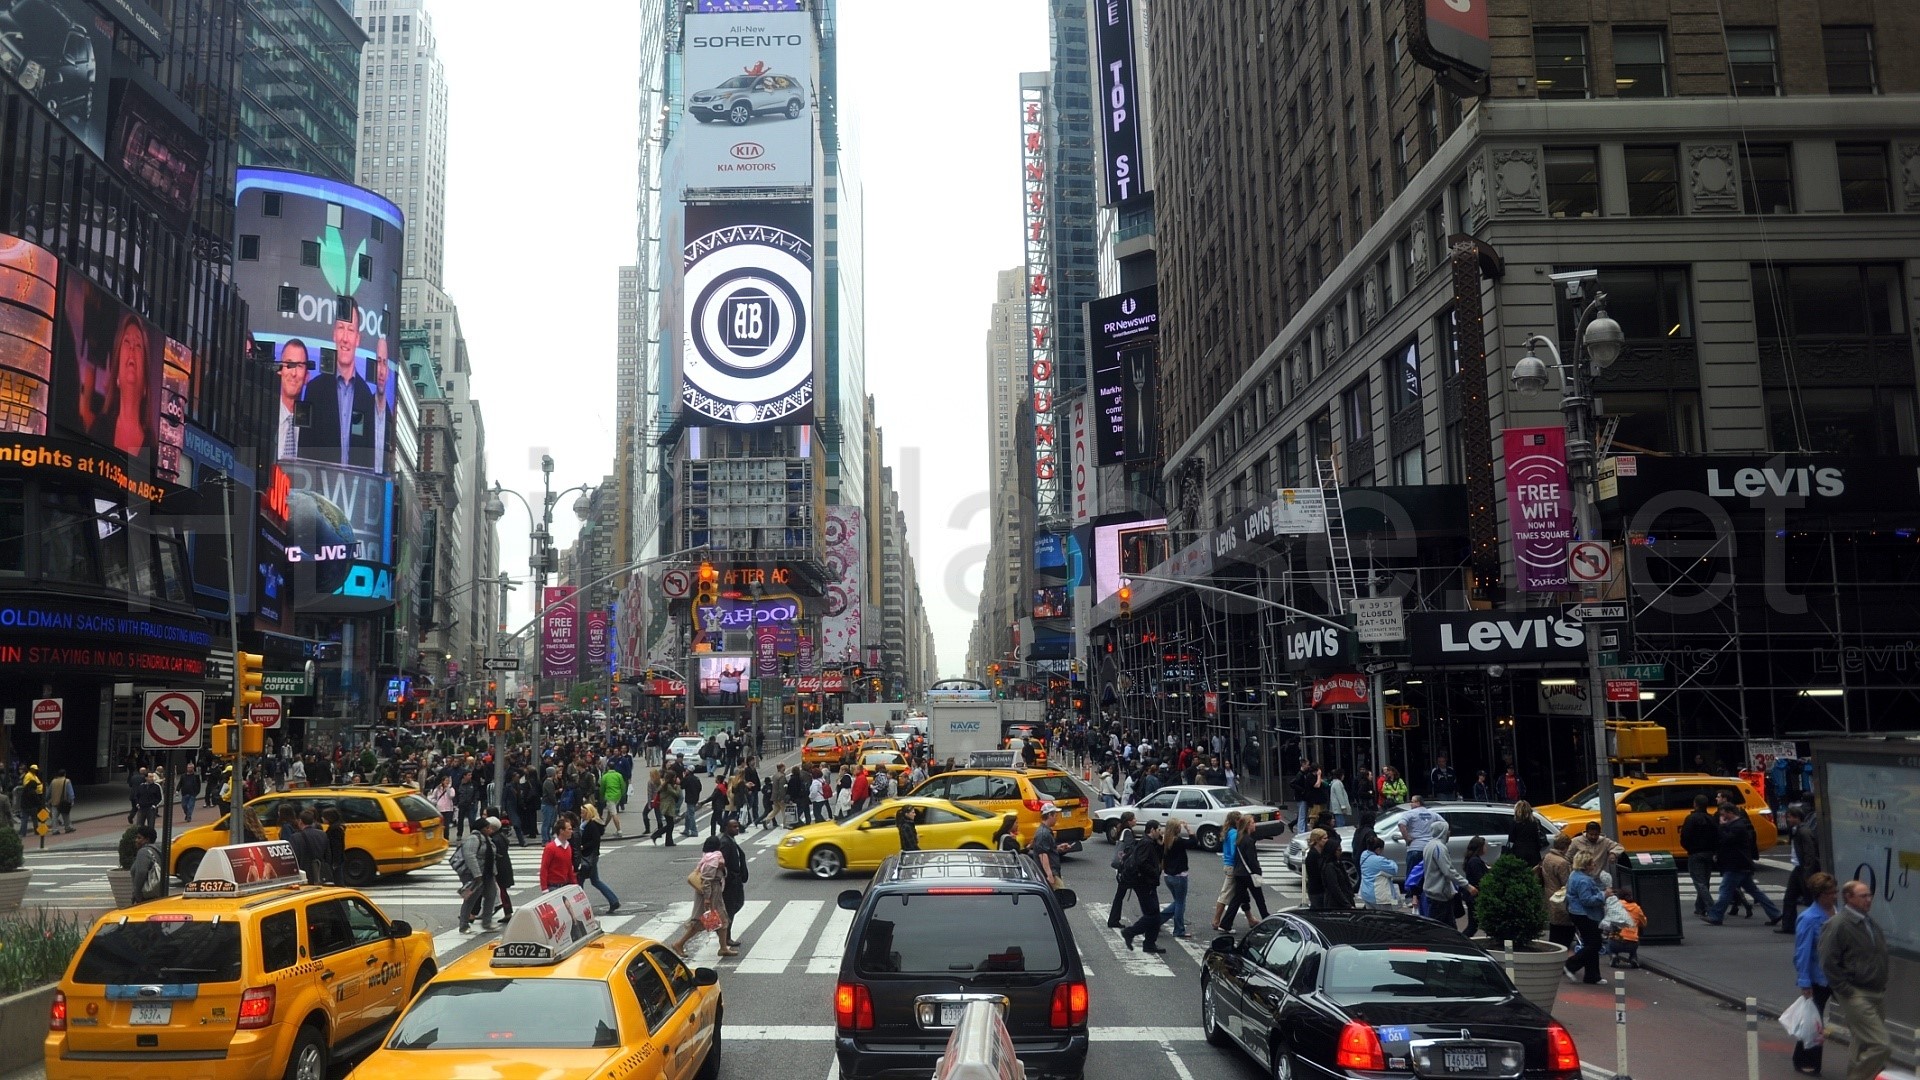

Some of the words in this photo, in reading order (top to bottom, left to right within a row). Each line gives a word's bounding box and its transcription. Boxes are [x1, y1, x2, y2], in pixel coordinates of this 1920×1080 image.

[693, 35, 802, 48] SORENTO
[1110, 60, 1126, 132] TOP
[736, 146, 760, 156] KIA
[736, 163, 776, 171] MOTORS
[1116, 155, 1130, 200] ST
[733, 302, 764, 340] AB
[1032, 326, 1055, 480] YOUNG
[184, 429, 235, 470] WRIGLEY'S
[1074, 402, 1086, 519] RICOH
[0, 444, 73, 468] nights
[78, 457, 94, 473] at
[98, 460, 128, 488] 11:35pm
[128, 481, 137, 494] on
[138, 481, 165, 503] ABC-7
[269, 463, 291, 523] JVC
[1517, 483, 1560, 501] FREE
[1521, 501, 1559, 519] WIFI
[1528, 521, 1546, 529] NOW
[1541, 530, 1570, 539] SQUARE
[314, 544, 347, 561] JVC
[343, 564, 392, 602] DA
[724, 569, 765, 584] AFTER
[771, 568, 788, 584] AC
[699, 605, 796, 625] YAHOO!
[1575, 608, 1593, 617] ONE
[1601, 607, 1620, 616] WAY
[0, 608, 72, 629] OLDMAN
[77, 614, 115, 633] SACHS
[118, 618, 139, 635] WITH
[140, 621, 163, 638] FRAUD
[164, 625, 188, 642] COSTING
[549, 617, 573, 627] FREE
[550, 628, 571, 637] WIFI
[29, 647, 90, 665] STAYING
[94, 650, 105, 665] IN
[128, 653, 135, 667] 5
[137, 654, 170, 670] HENDRICK
[170, 657, 183, 671] CAR
[262, 676, 304, 684] TARBUCKS
[1619, 668, 1627, 679] W
[1634, 667, 1650, 679] 44
[950, 721, 980, 730] NAVAC
[1860, 798, 1886, 811] OLD
[1638, 825, 1666, 837] TAXI
[1860, 825, 1894, 837] NEVER
[267, 844, 293, 858] BODIES
[200, 882, 223, 892] 5G37
[508, 945, 536, 956] 6G72
[381, 961, 402, 986] TAXI
[1389, 1032, 1403, 1041] 061
